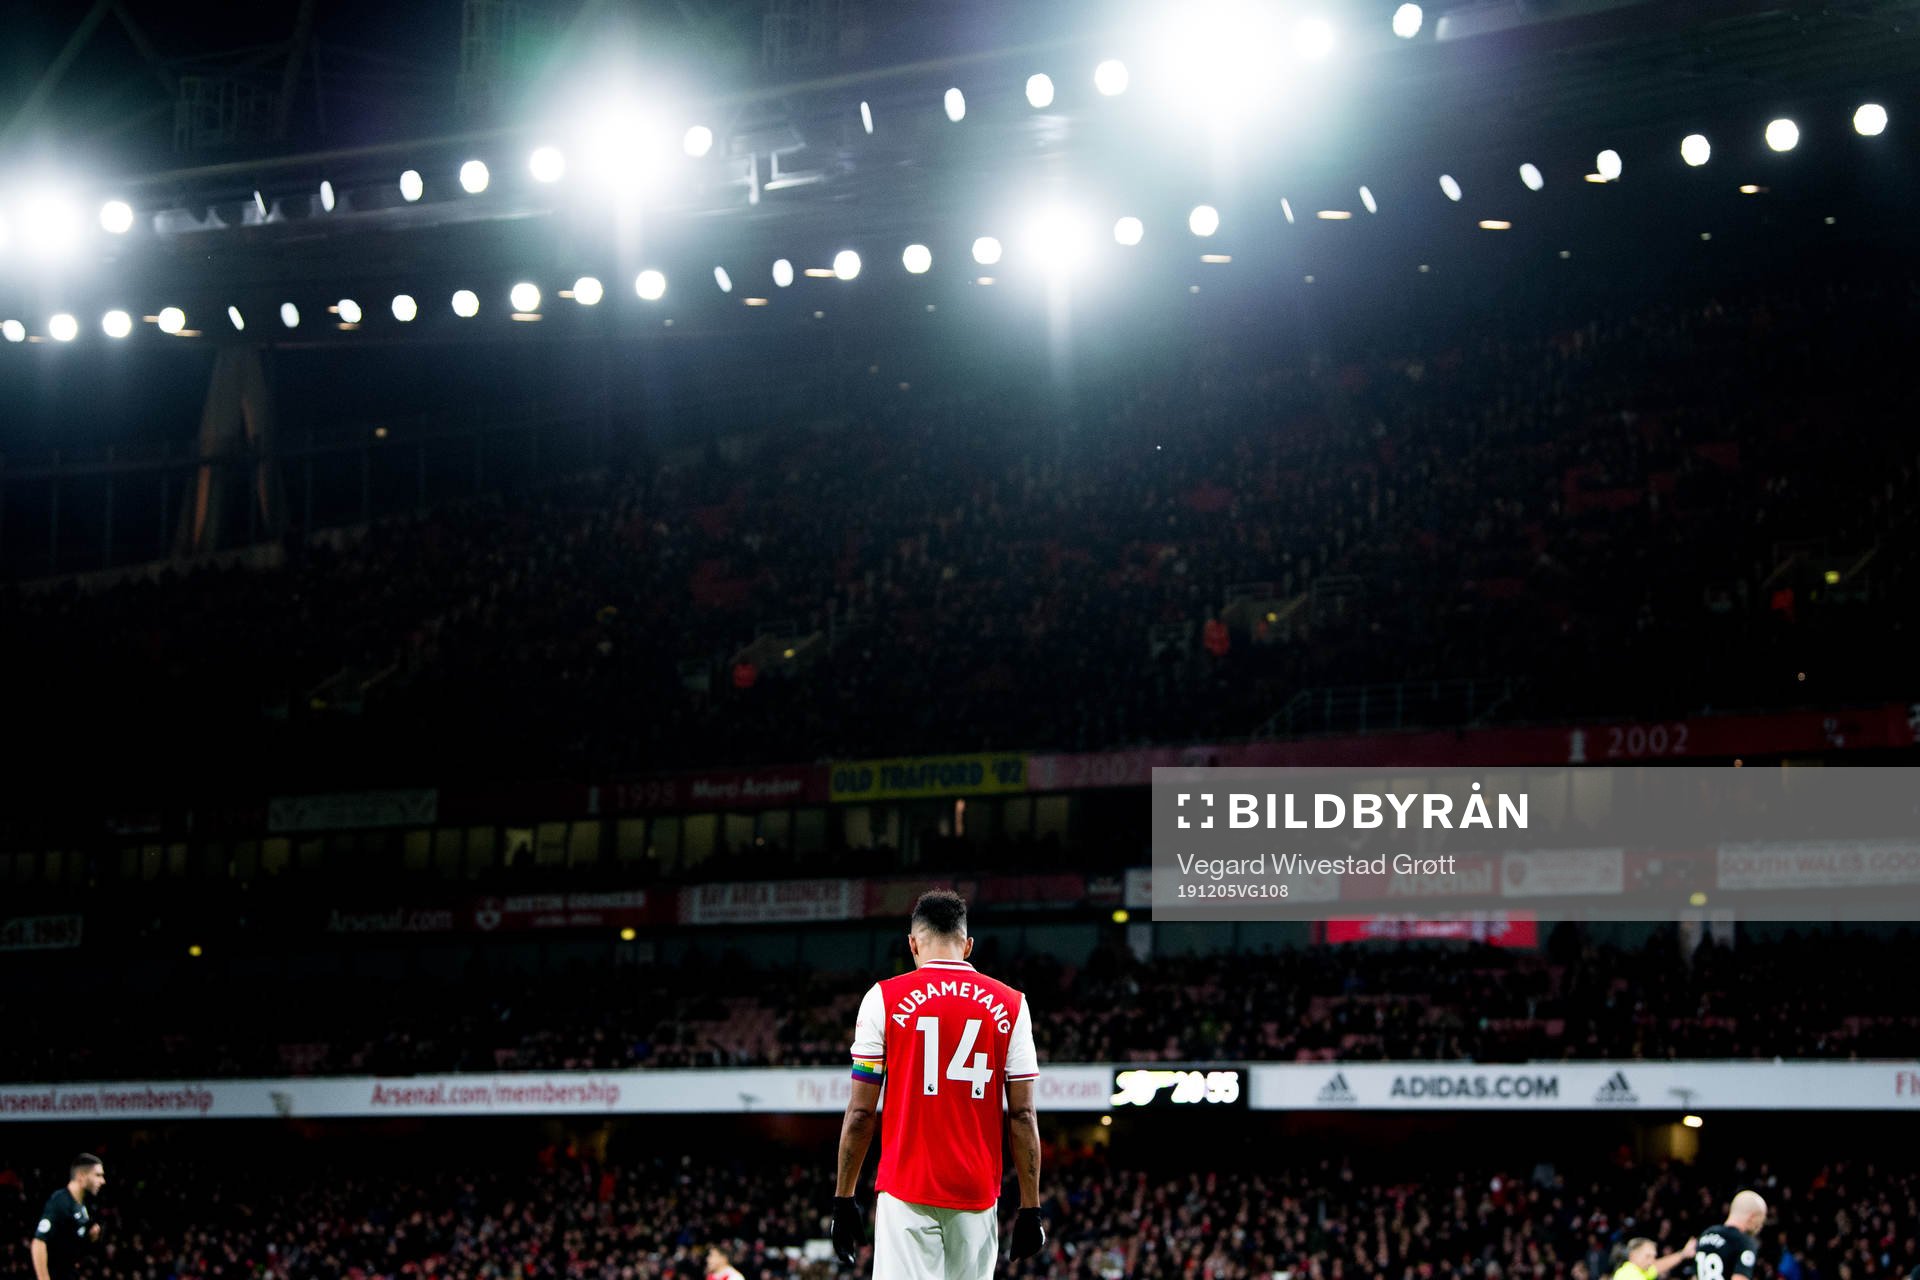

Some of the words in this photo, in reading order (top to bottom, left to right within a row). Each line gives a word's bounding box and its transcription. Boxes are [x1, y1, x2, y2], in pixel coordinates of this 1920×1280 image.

[1607, 722, 1689, 758] 2002
[834, 768, 873, 792] OLD
[879, 762, 984, 789] TRAFFORD
[327, 905, 454, 932] Arsenal.com
[891, 980, 1011, 1035] AUBAMEYANG
[915, 1016, 994, 1099] 14
[371, 1079, 621, 1110] Arsenal.com/membership
[1042, 1077, 1103, 1098] Ocean
[1389, 1075, 1560, 1098] ADIDAS.COM
